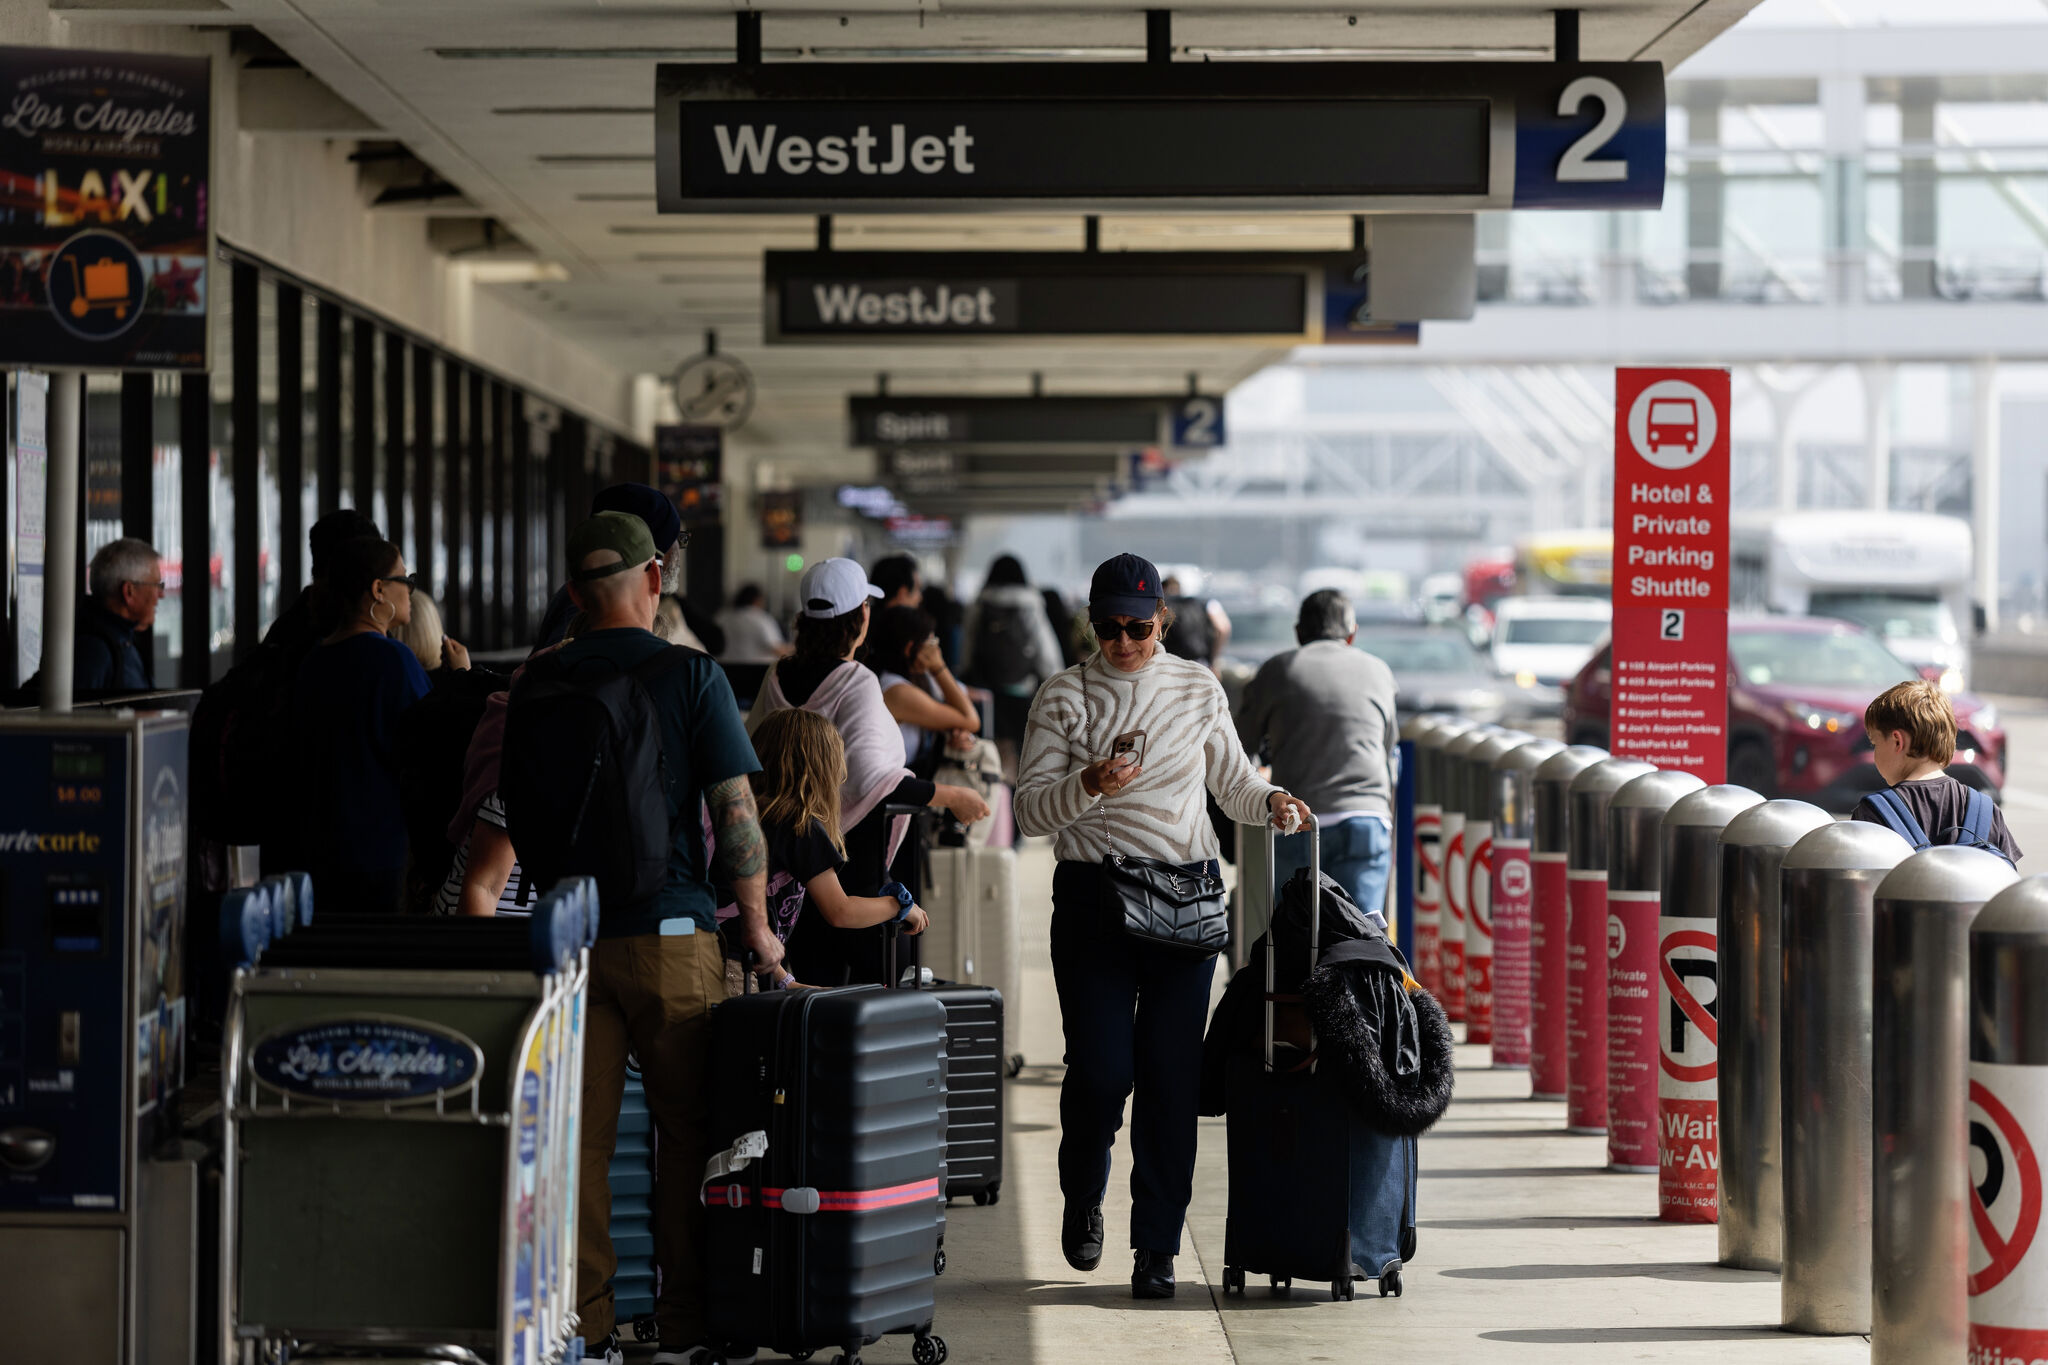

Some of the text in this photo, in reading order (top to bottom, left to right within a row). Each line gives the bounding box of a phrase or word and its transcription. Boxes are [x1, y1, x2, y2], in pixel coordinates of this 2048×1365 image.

[19, 66, 185, 99] WELCOME TO FRIENDLY
[2, 92, 199, 142] Los Angeles
[1555, 76, 1630, 182] 2
[42, 137, 161, 156] WORLD AIRPORTS
[713, 123, 976, 175] WestJet
[815, 286, 995, 325] WestJet
[877, 411, 949, 442] Spirit
[1184, 400, 1217, 444] 2
[1631, 483, 1714, 504] Hotel &
[1632, 514, 1711, 535] Private
[1628, 545, 1714, 570] Parking
[1630, 576, 1711, 597] Shuttle
[1664, 612, 1680, 637] 2
[1647, 661, 1679, 674] Airport
[1680, 661, 1716, 674] Parking
[1647, 676, 1679, 689] Airport
[1680, 677, 1716, 689] Parking
[1627, 692, 1659, 704] Airport
[1627, 708, 1659, 720] Airport
[1652, 723, 1684, 736] Airport
[1686, 723, 1721, 737] Parking
[1646, 754, 1681, 768] Parking
[1612, 969, 1648, 982] Private
[279, 1043, 448, 1081] Los Angeles
[1671, 1195, 1692, 1206] CALL
